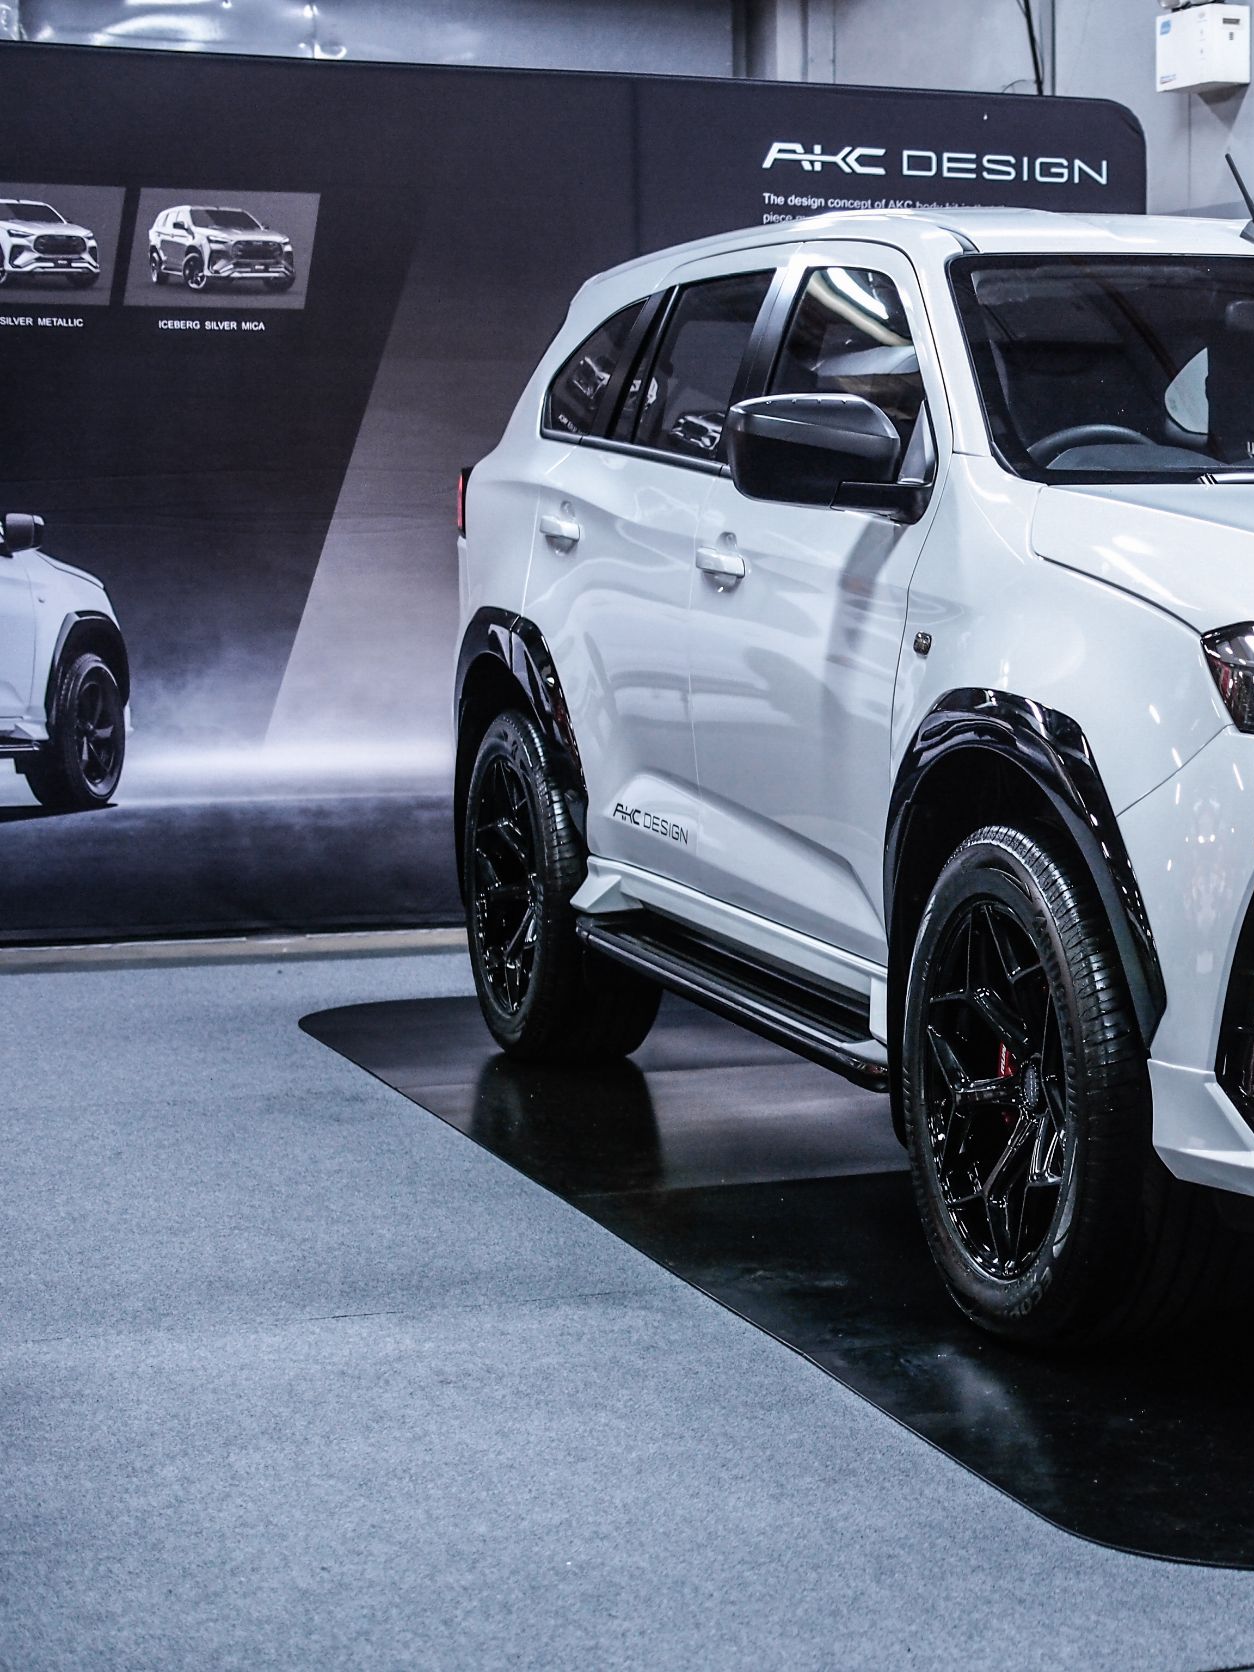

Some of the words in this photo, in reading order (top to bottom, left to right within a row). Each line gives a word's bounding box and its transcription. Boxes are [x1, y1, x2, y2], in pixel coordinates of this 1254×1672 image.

[902, 150, 1107, 185] DESIGN
[763, 193, 785, 205] The
[787, 194, 825, 209] design
[828, 199, 872, 209] concept
[874, 199, 886, 209] of
[888, 200, 914, 209] AKC
[763, 212, 793, 224] piece
[0, 316, 33, 326] SILVER
[37, 317, 84, 327] METALLIC
[158, 320, 200, 330] ICEBERG
[205, 321, 237, 331] SILVER
[241, 321, 265, 331] MICA
[643, 812, 688, 845] DESIGN
